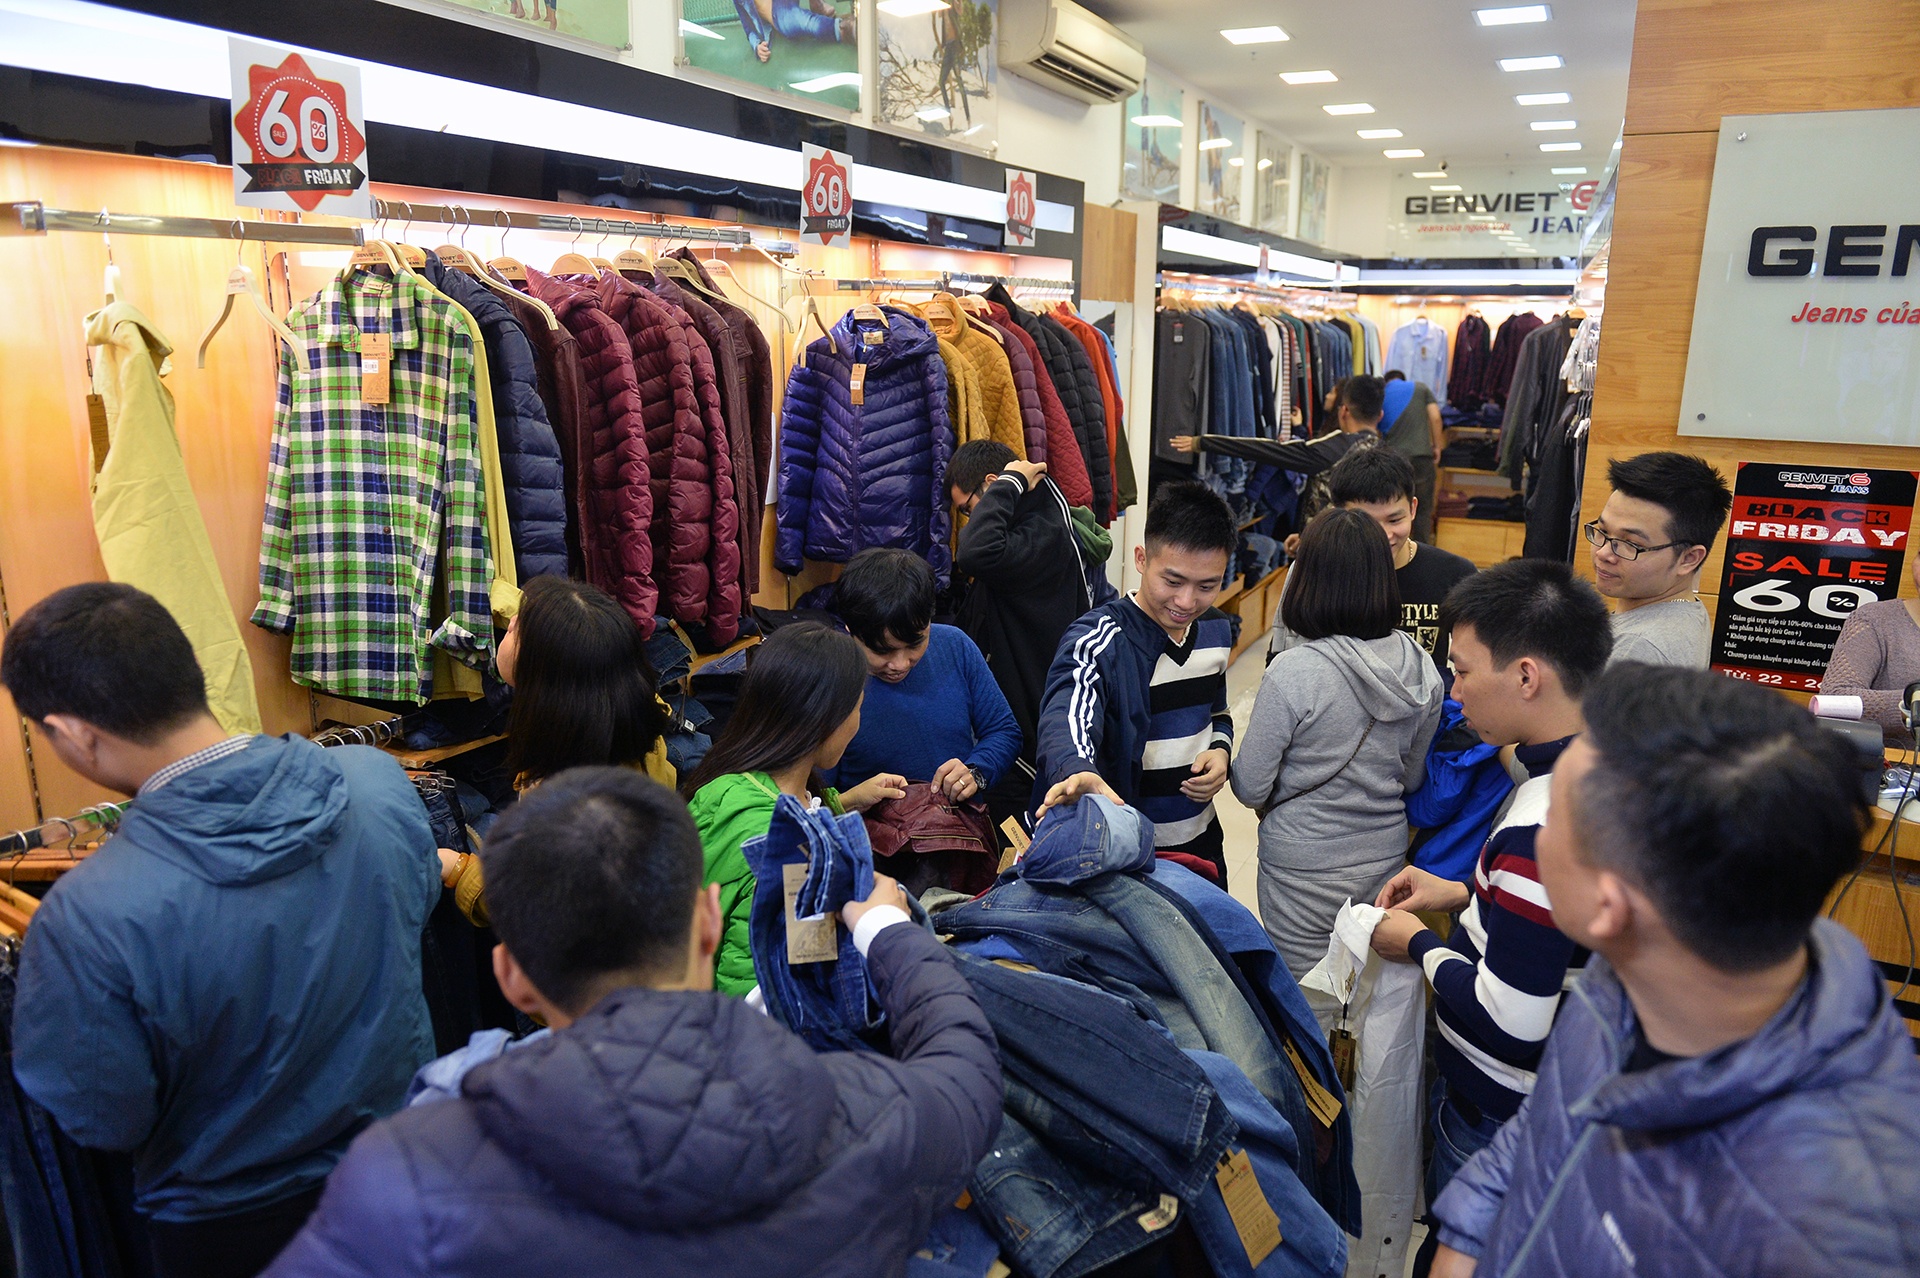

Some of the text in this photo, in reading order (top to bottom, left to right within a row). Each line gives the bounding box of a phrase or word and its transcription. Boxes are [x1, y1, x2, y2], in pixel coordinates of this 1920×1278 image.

[259, 90, 339, 164] 60
[272, 130, 286, 139] SALE
[304, 168, 352, 185] FRIDAY
[812, 172, 843, 216] 60
[1405, 193, 1559, 215] GENVIET
[1013, 190, 1028, 221] 10
[1791, 302, 1868, 324] Jeans
[1778, 471, 1846, 484] GENVIET
[1831, 485, 1869, 494] JEANS
[1747, 503, 1890, 526] BLACK
[1732, 520, 1907, 547] FRIDAY
[1732, 552, 1888, 581] SALE
[1733, 579, 1878, 619] 60
[1401, 604, 1439, 620] TYLE
[1788, 620, 1813, 628] 10%-60%
[1758, 674, 1783, 684] 22
